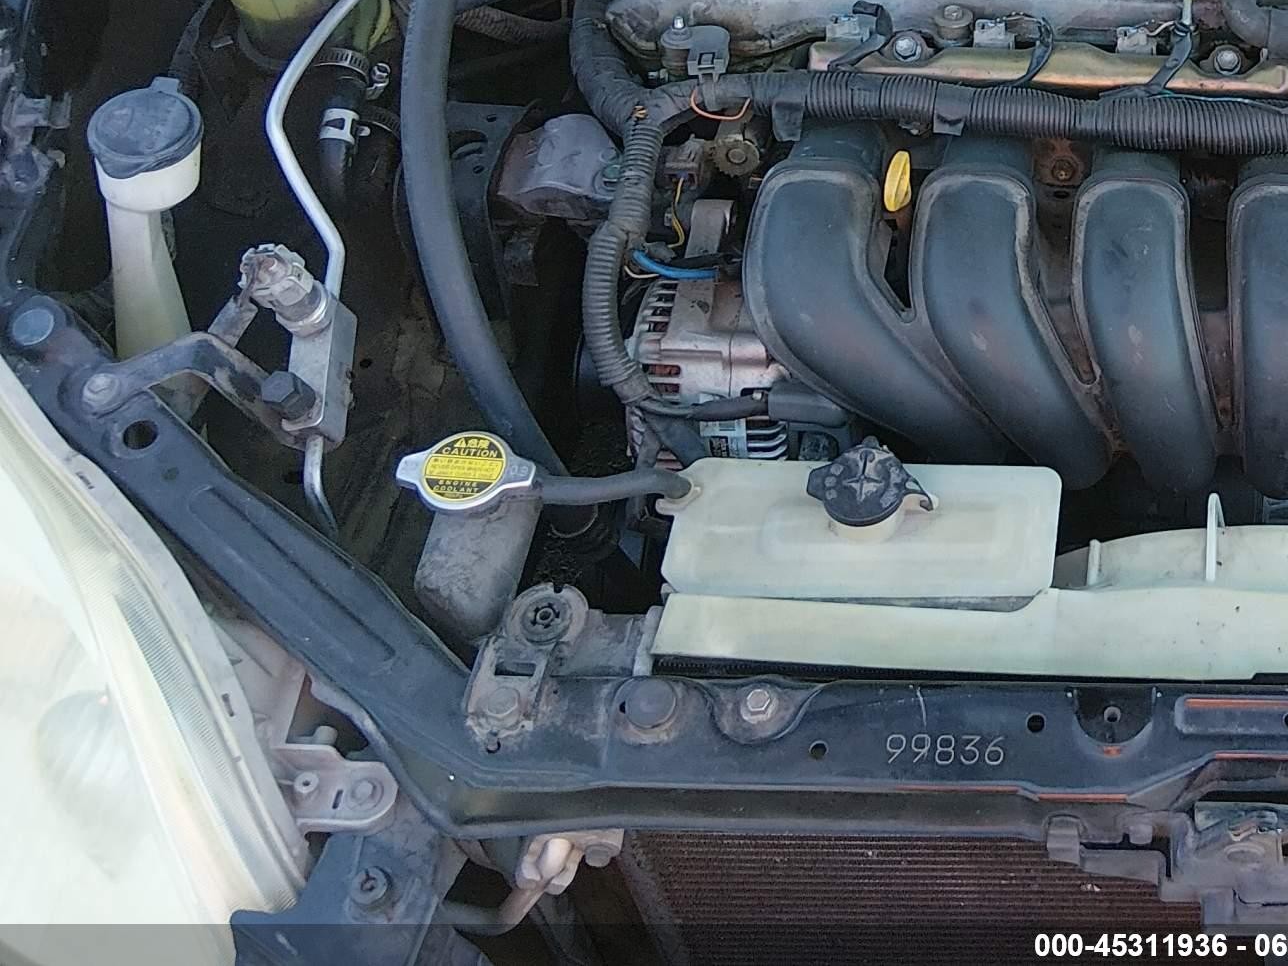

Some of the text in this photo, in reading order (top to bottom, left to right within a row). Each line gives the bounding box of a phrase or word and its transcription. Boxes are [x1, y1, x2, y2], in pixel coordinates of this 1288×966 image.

[441, 446, 498, 458] CAUTION
[438, 479, 478, 487] ENGINE
[432, 485, 480, 493] COOLANT
[886, 733, 1006, 765] 99836
